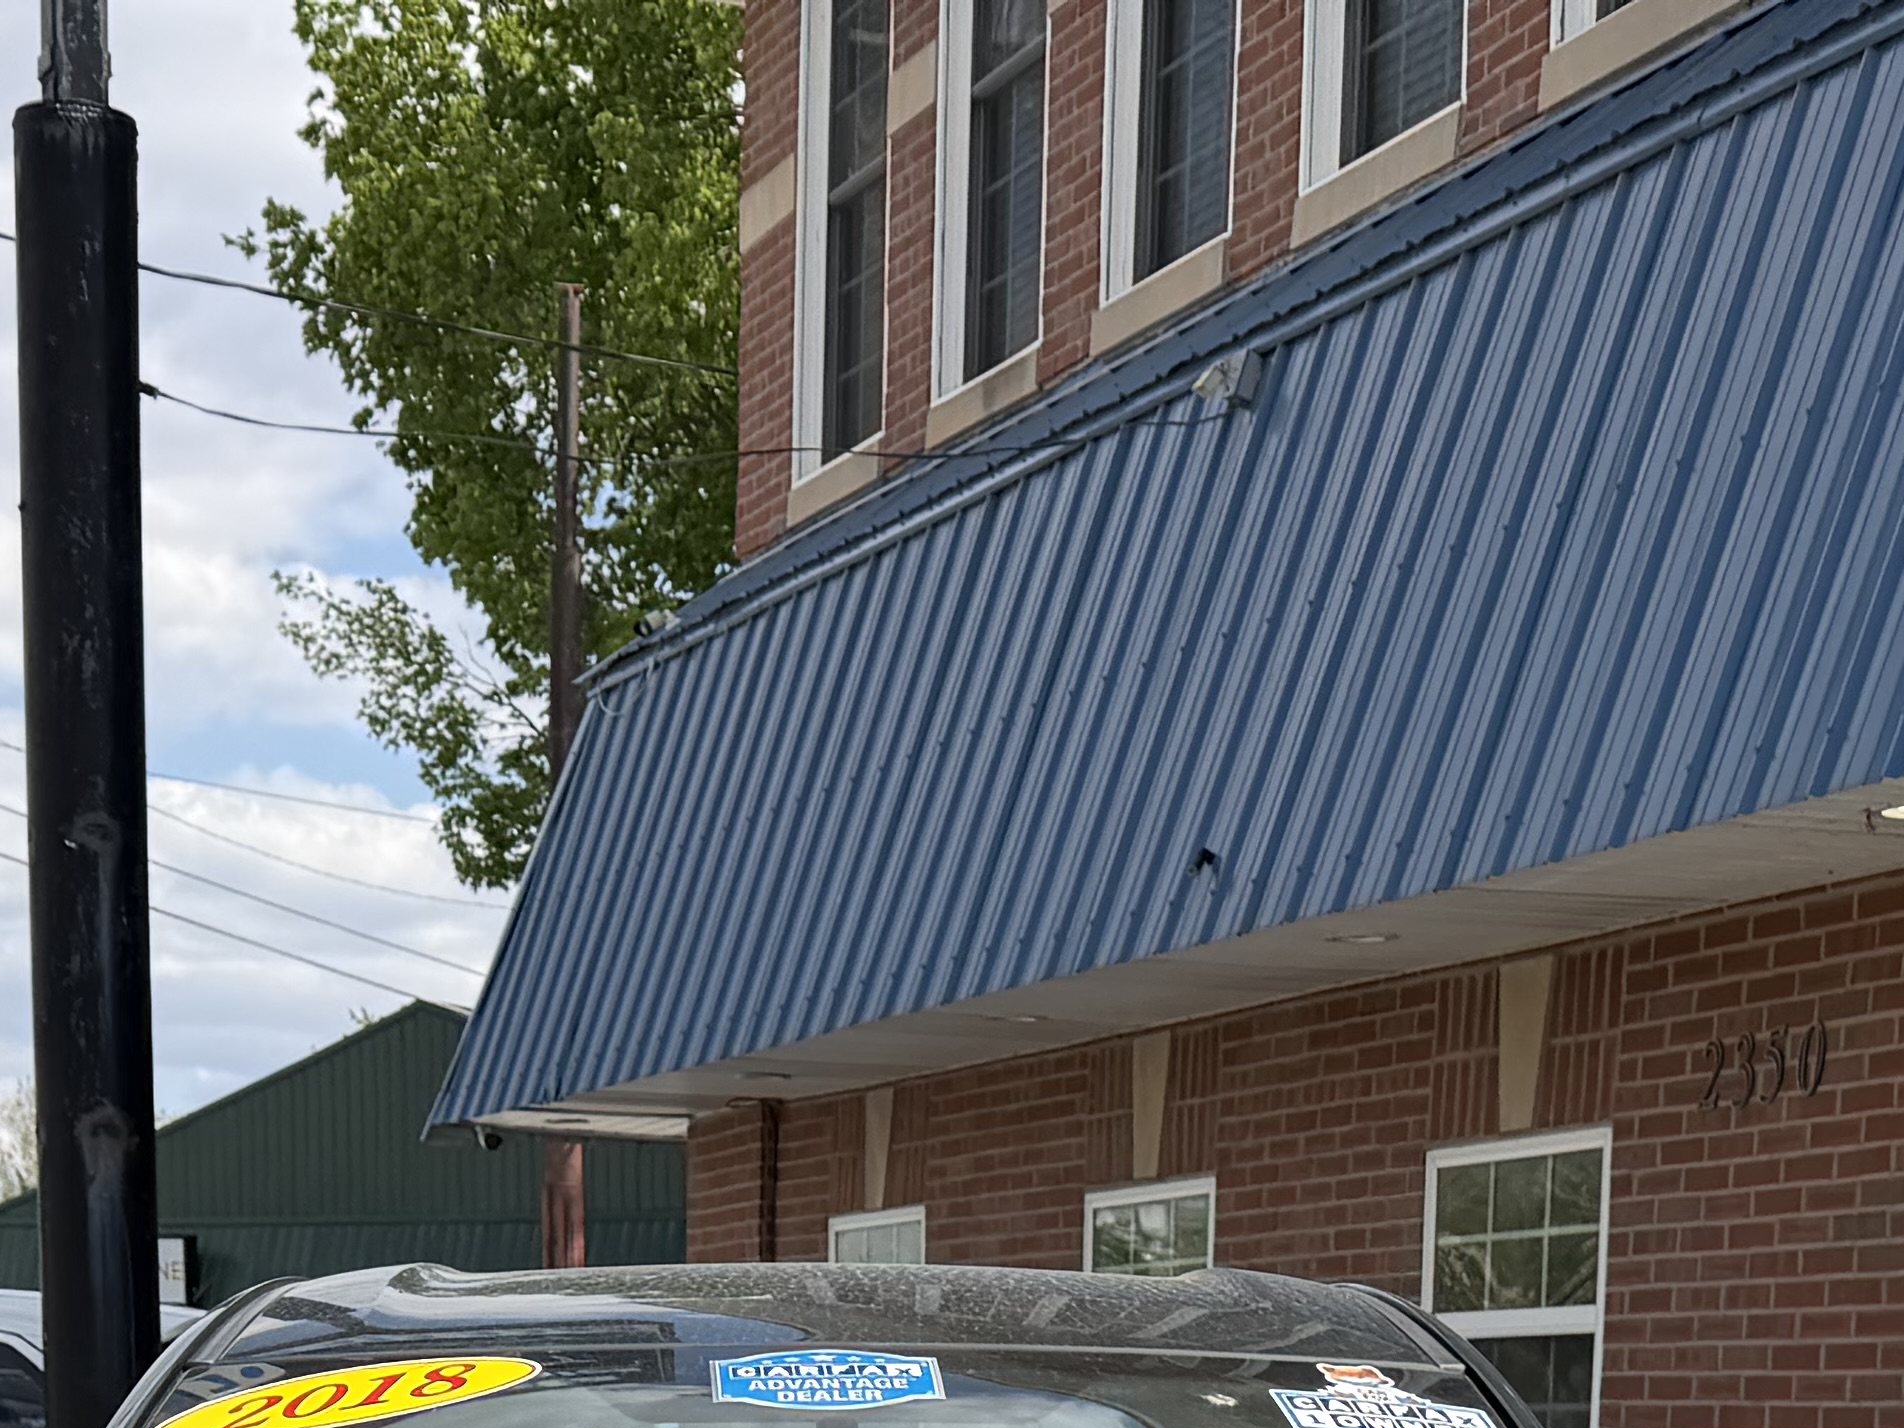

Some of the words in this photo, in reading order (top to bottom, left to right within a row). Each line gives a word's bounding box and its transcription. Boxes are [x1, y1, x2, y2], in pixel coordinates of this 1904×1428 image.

[1698, 1019, 1827, 1111] 2350
[748, 1378, 910, 1391] ADVANTAGE
[777, 1389, 884, 1402] DEALER
[1292, 1397, 1478, 1428] CARFAX
